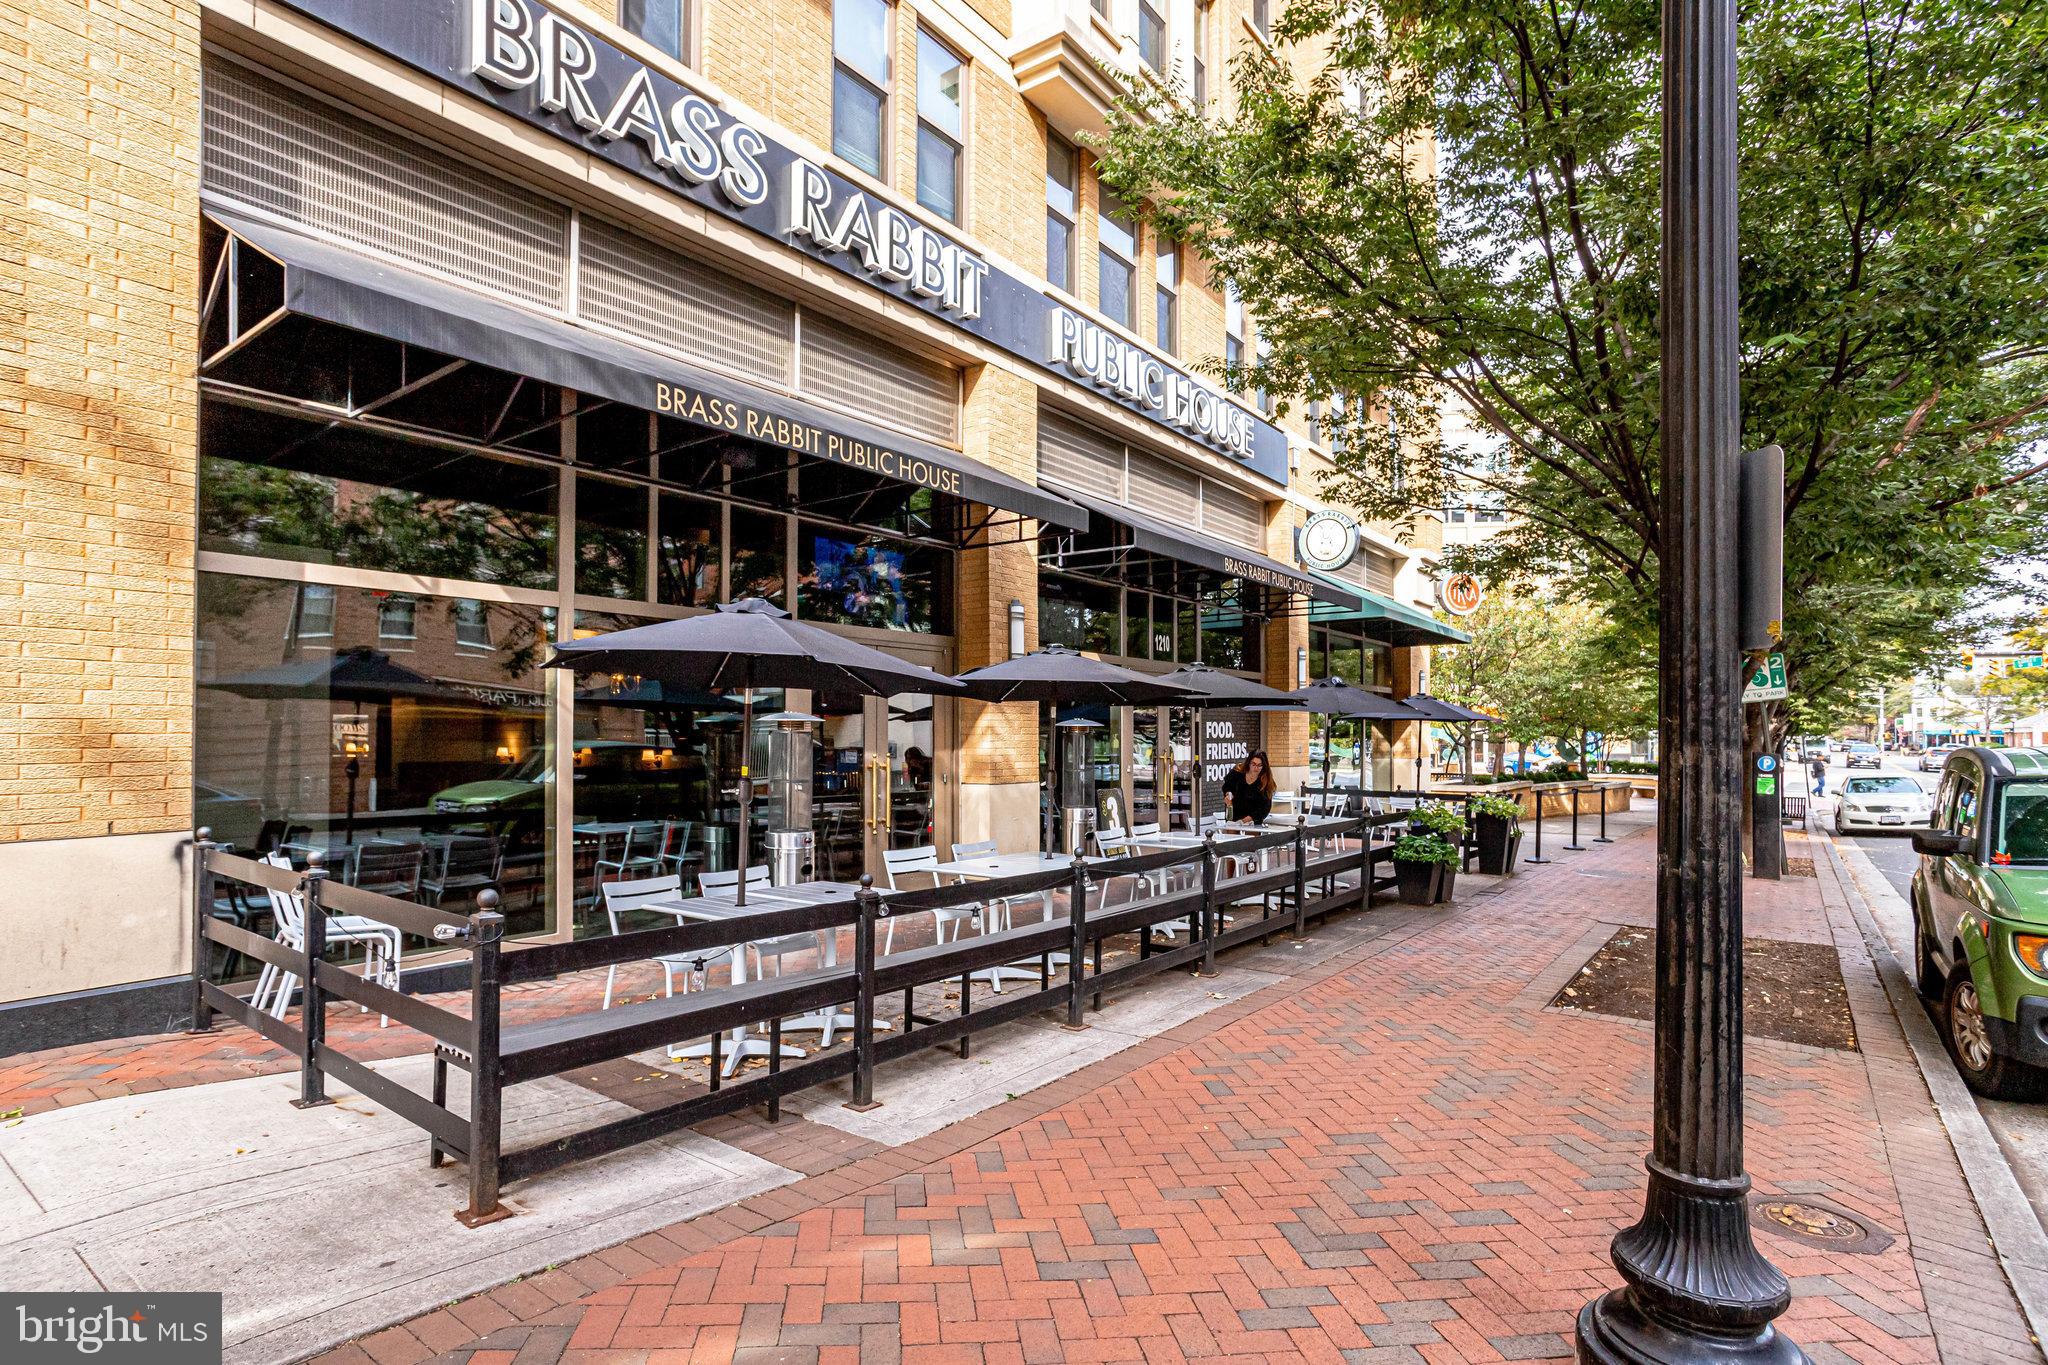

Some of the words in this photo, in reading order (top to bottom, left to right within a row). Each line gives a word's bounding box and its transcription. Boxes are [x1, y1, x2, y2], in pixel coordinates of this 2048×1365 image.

[471, 0, 768, 207] BRASS
[788, 156, 989, 320] RABBIT
[1051, 306, 1164, 410] PUBLIC
[1165, 372, 1255, 459] HOUSE
[656, 382, 738, 430] BRASS
[746, 409, 822, 453] RABBIT
[828, 434, 894, 475] PUBLIC
[899, 456, 960, 494] HOUSE
[1224, 557, 1247, 577] BRASS
[1248, 564, 1271, 584] RABBIT
[1271, 571, 1293, 591] PUBLIC
[1293, 578, 1314, 595] HOUSE
[1155, 634, 1170, 652] 1210
[1770, 657, 1781, 668] 2
[1766, 690, 1784, 698] PARK
[1206, 721, 1235, 739] FOOD.
[1206, 742, 1249, 760] FRIENDS.
[1763, 758, 1772, 769] P
